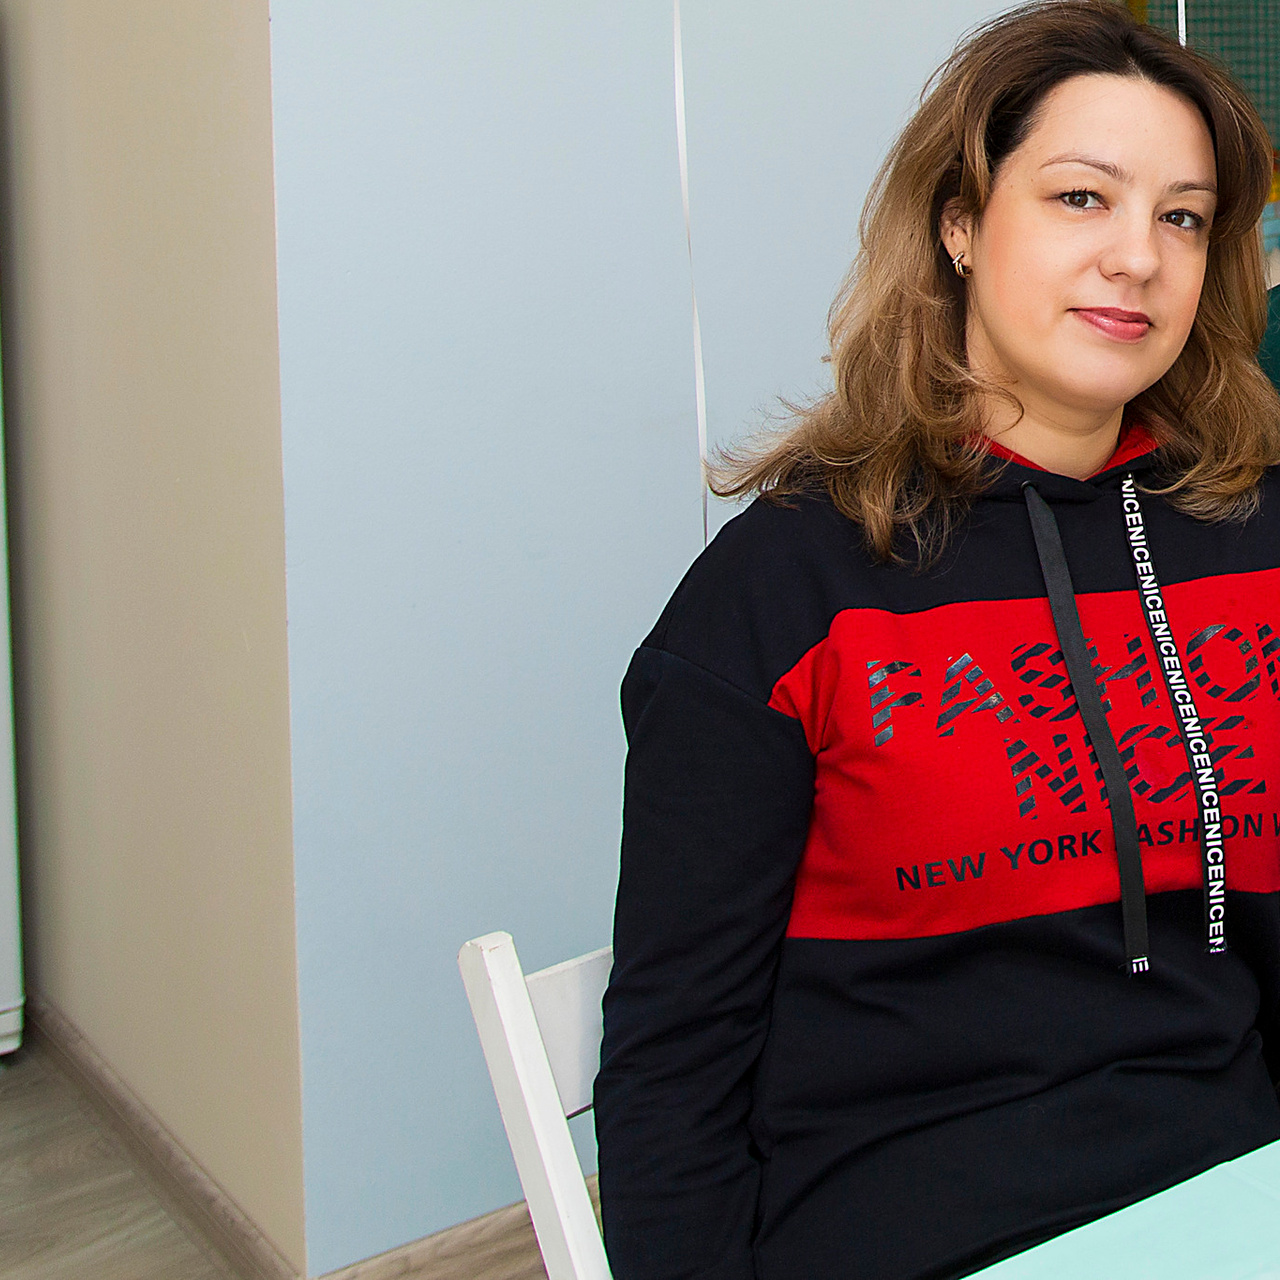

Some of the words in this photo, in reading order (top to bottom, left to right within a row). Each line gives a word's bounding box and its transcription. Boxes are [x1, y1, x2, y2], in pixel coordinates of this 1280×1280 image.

[895, 852, 986, 891] NEW
[1000, 829, 1103, 871] YORK
[1136, 812, 1263, 847] ASHON
